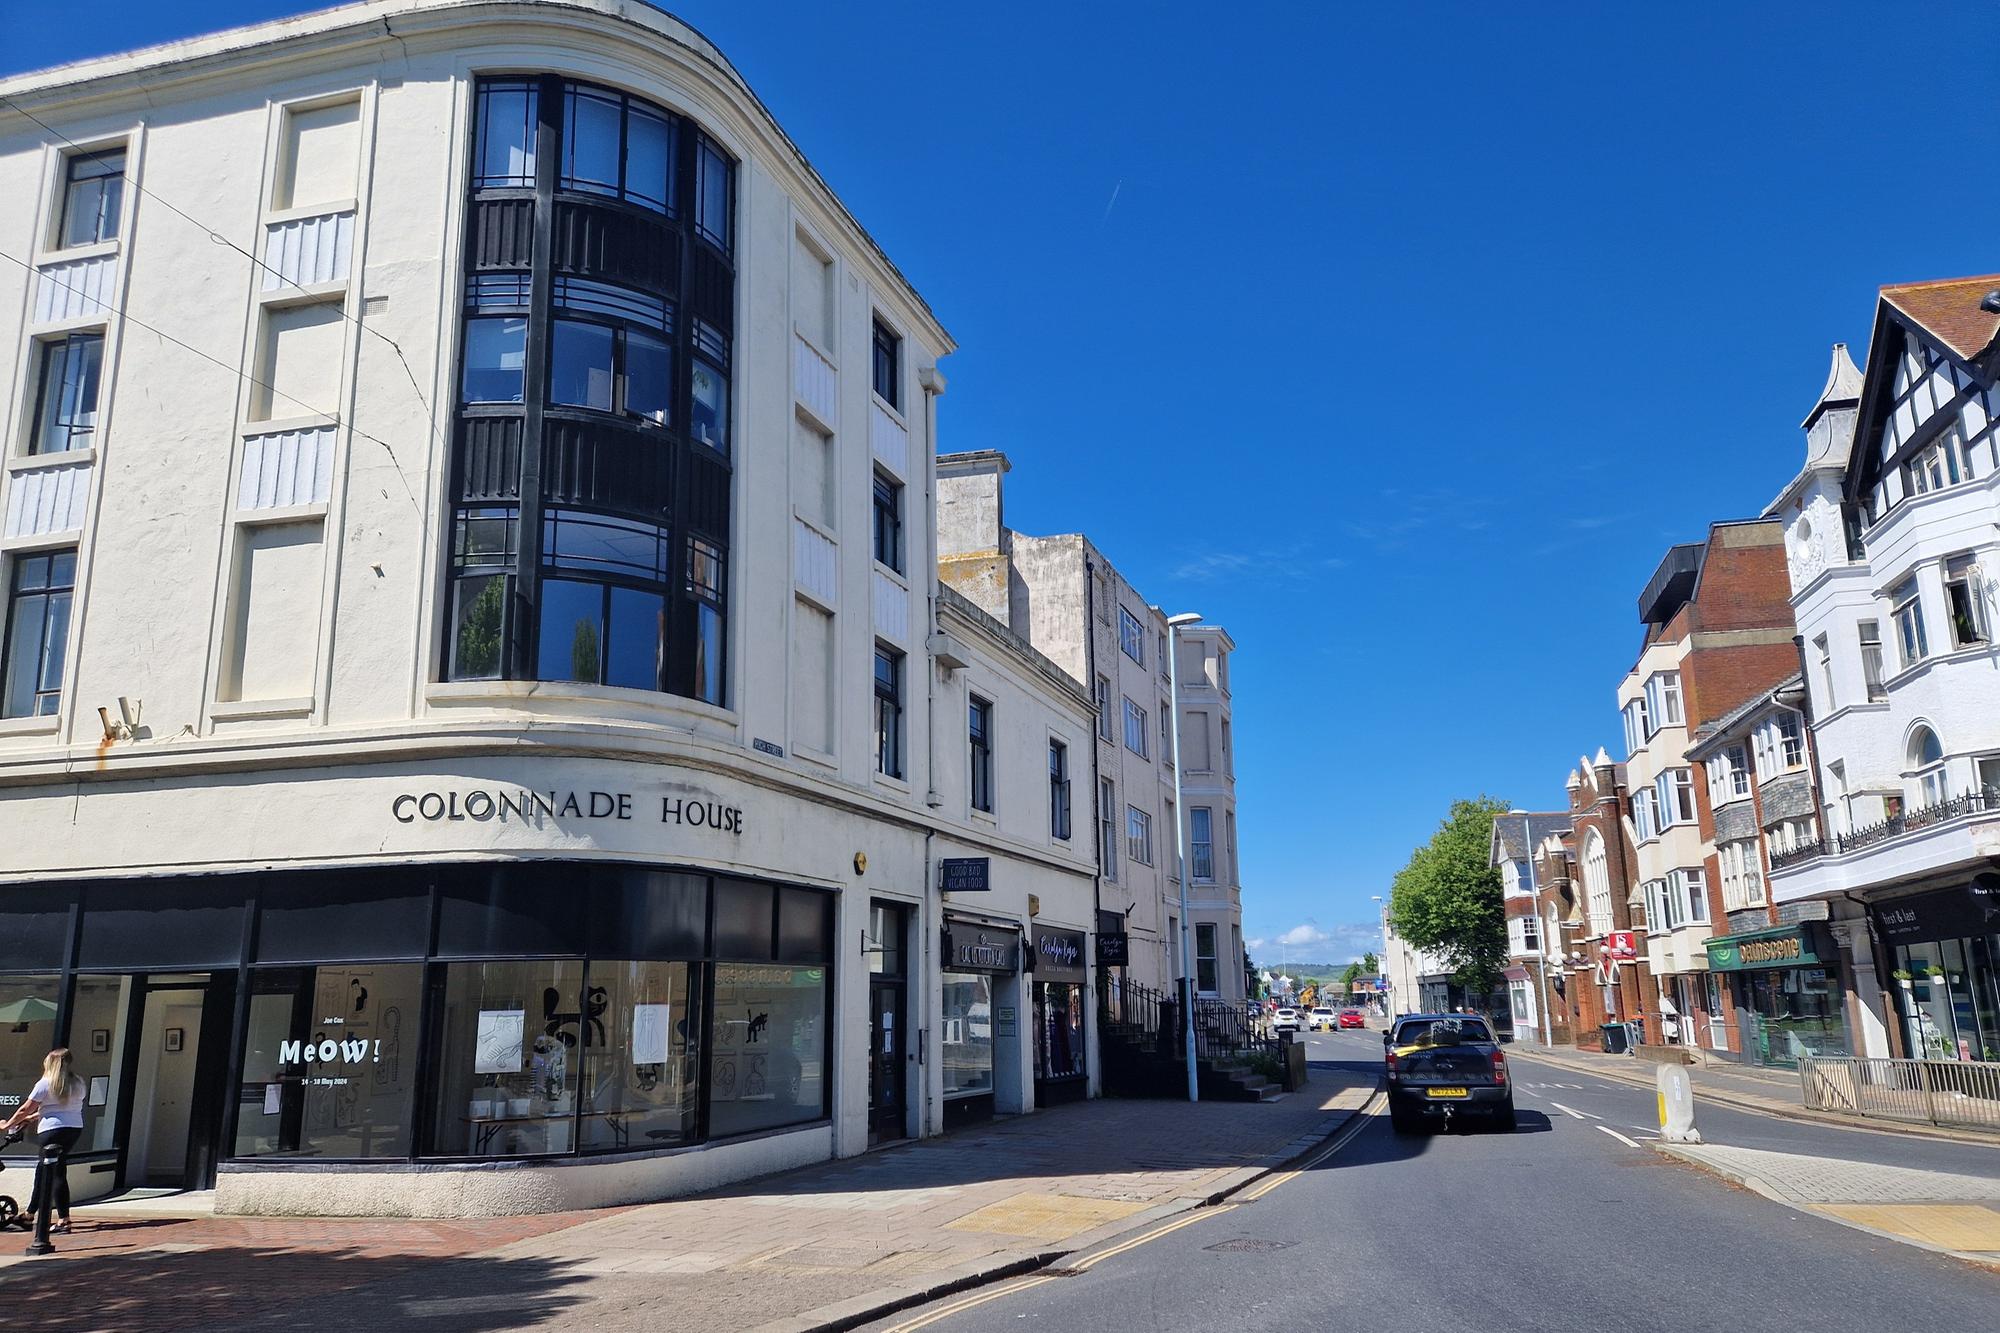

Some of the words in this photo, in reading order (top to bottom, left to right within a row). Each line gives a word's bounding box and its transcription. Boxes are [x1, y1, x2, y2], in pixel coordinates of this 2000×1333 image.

[392, 790, 632, 823] COLONNADE
[661, 797, 743, 834] HOUSE
[950, 865, 967, 877] GOOD
[968, 865, 981, 876] BAD
[947, 878, 967, 889] VEGAN
[967, 877, 984, 888] FOOD
[1882, 912, 1897, 925] first
[1896, 910, 1904, 923] &
[1901, 908, 1917, 922] last
[301, 1078, 309, 1086] 14
[321, 1078, 333, 1089] May
[334, 1078, 348, 1086] 2024
